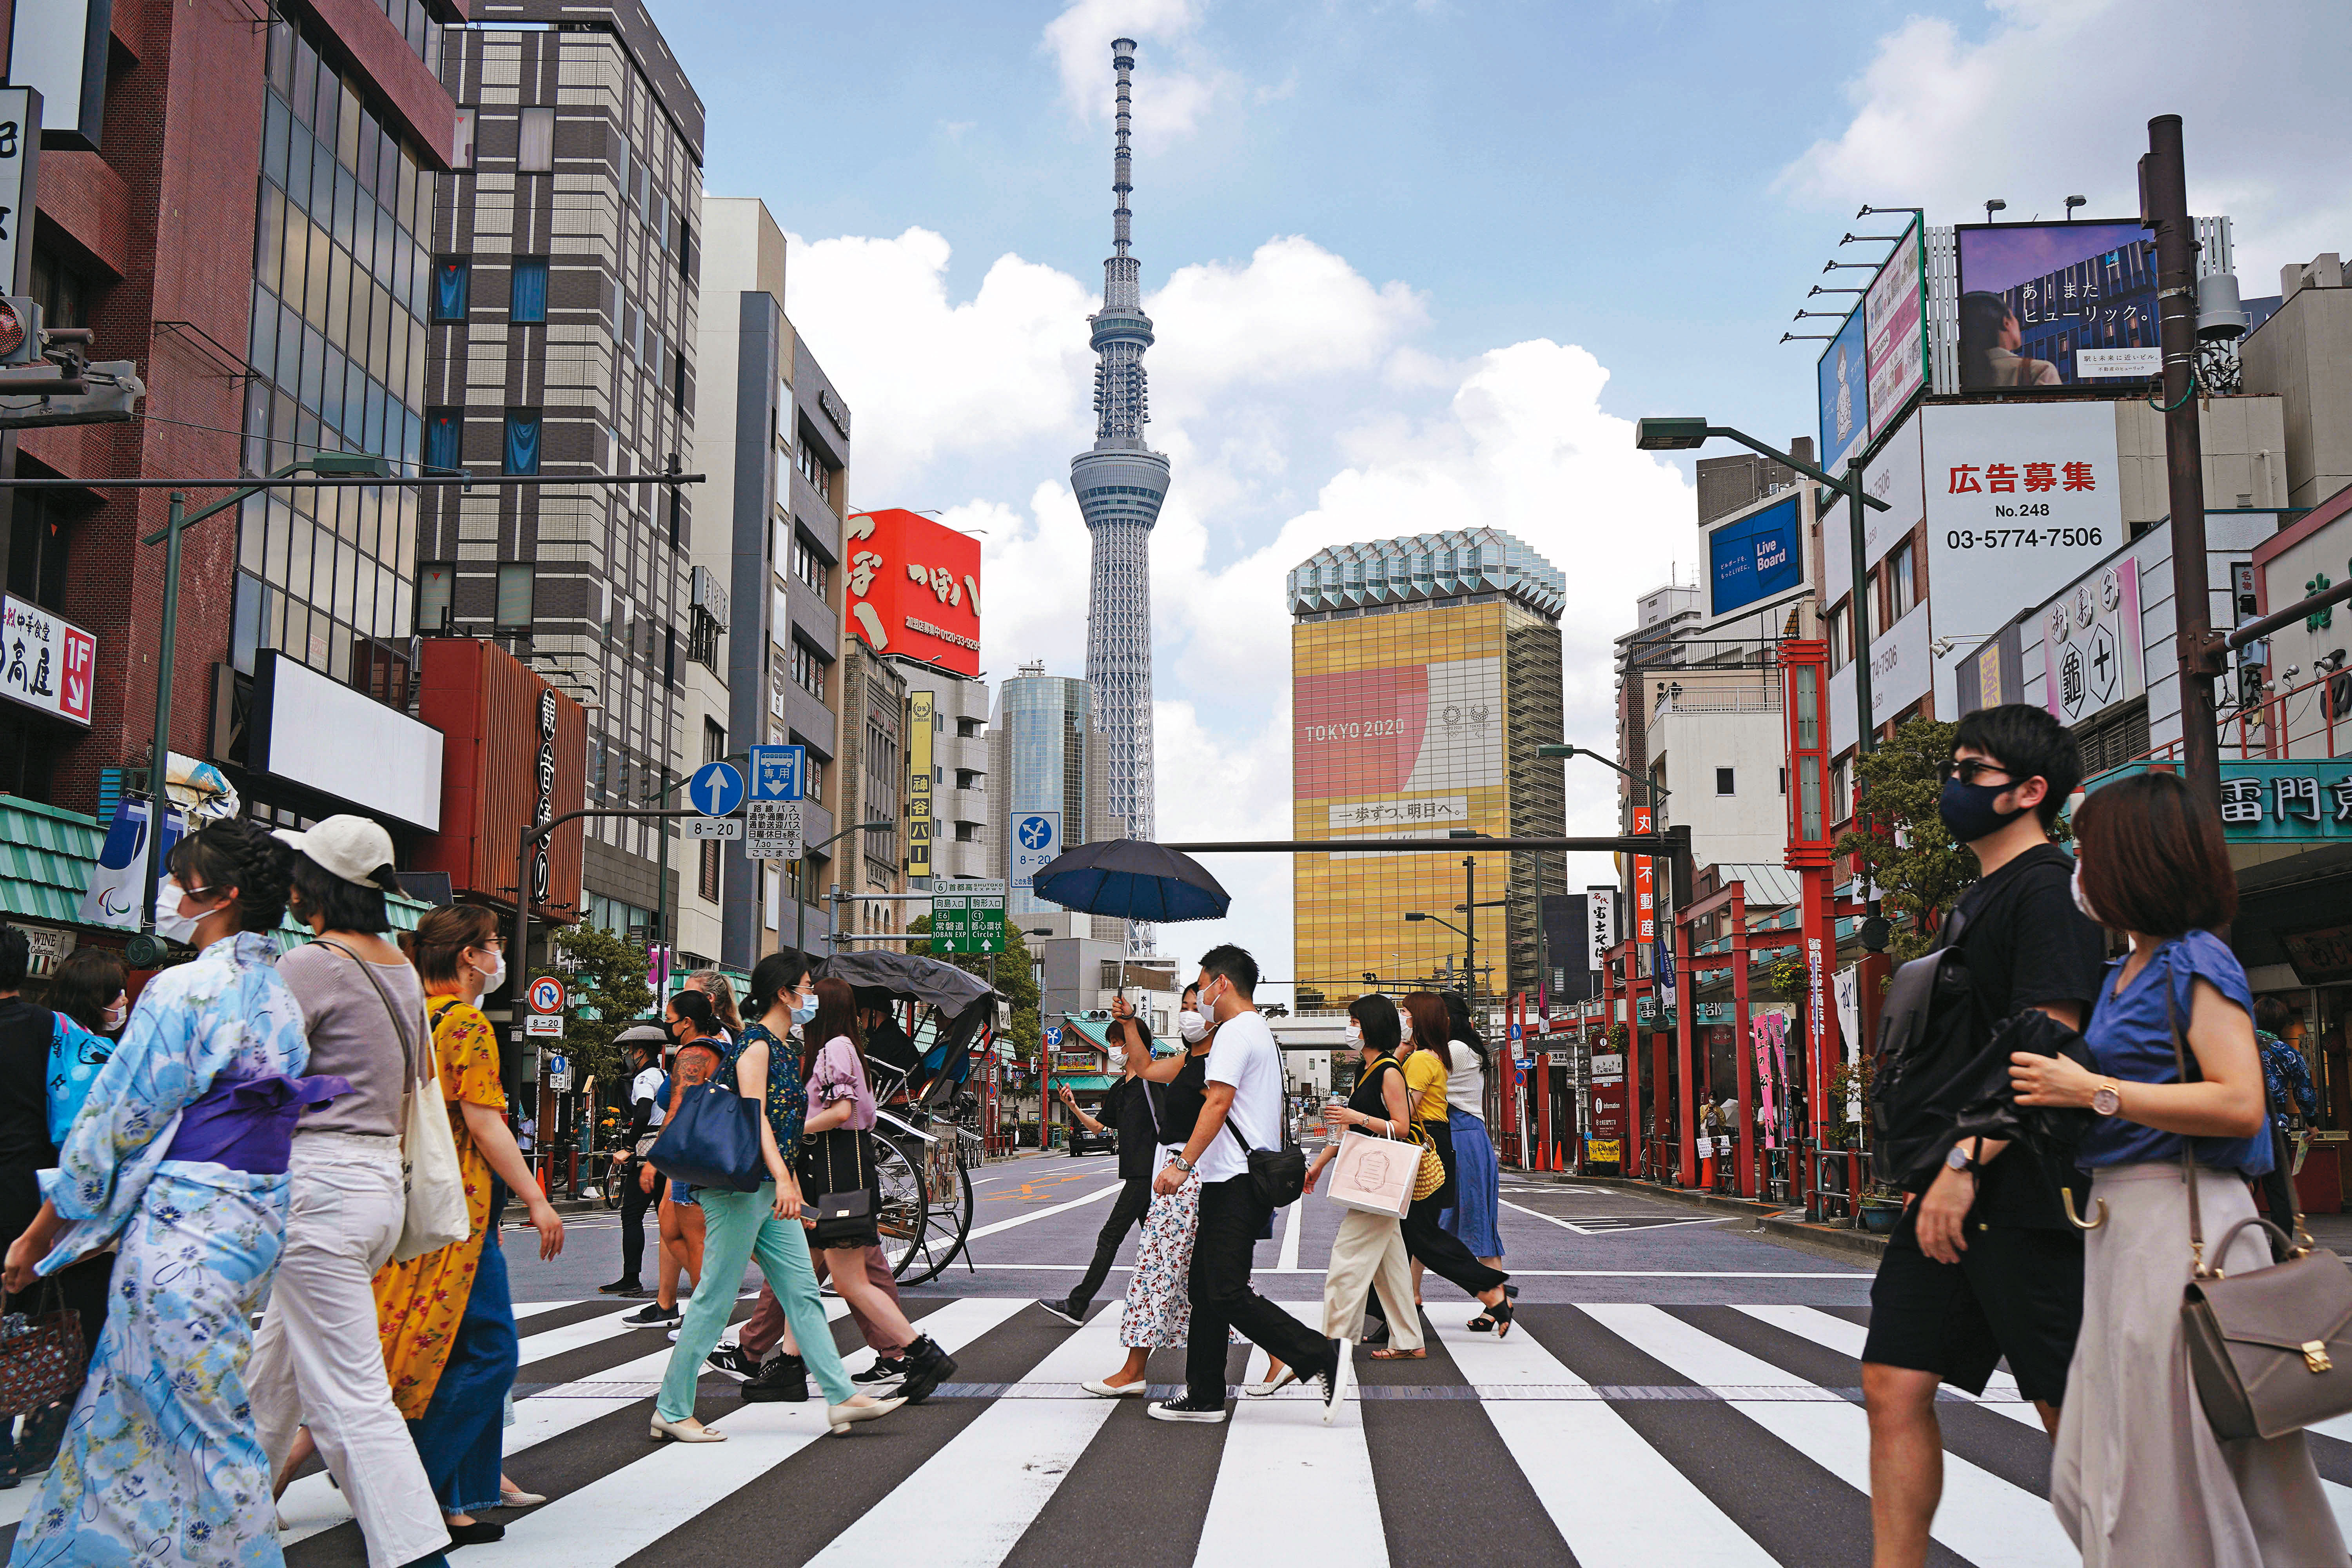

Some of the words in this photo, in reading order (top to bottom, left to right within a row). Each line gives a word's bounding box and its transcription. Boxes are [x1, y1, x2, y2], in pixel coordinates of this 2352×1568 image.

[2024, 305, 2148, 323] ヒューリック。
[1948, 461, 2096, 495] 広告募集
[1757, 540, 1776, 557] Live
[1947, 528, 2102, 550] 03-5774-7506
[1757, 548, 1785, 571] Board
[905, 615, 940, 639] 加盟店募集中
[68, 637, 90, 672] 1F
[868, 701, 884, 727] KAMIYA
[886, 714, 897, 737] BAR
[1305, 721, 1360, 742] TOKYO
[1363, 718, 1405, 736] 2020
[764, 768, 789, 779] 専用
[749, 813, 800, 821] 通学・通園バス
[912, 776, 928, 862] 神谷バー
[1339, 802, 1460, 823] 一歩ずつ、明日へ。
[749, 821, 800, 829] 通勤送迎バス
[1637, 815, 1653, 937] 丸不動産
[936, 899, 964, 908] 向島入口
[973, 898, 1001, 907] 駒形入口
[936, 922, 964, 931] 常磐道
[971, 922, 1002, 931] 都心環状
[1593, 906, 1610, 958] 富士そば
[33, 931, 56, 947] WINE
[31, 945, 54, 956] Collections
